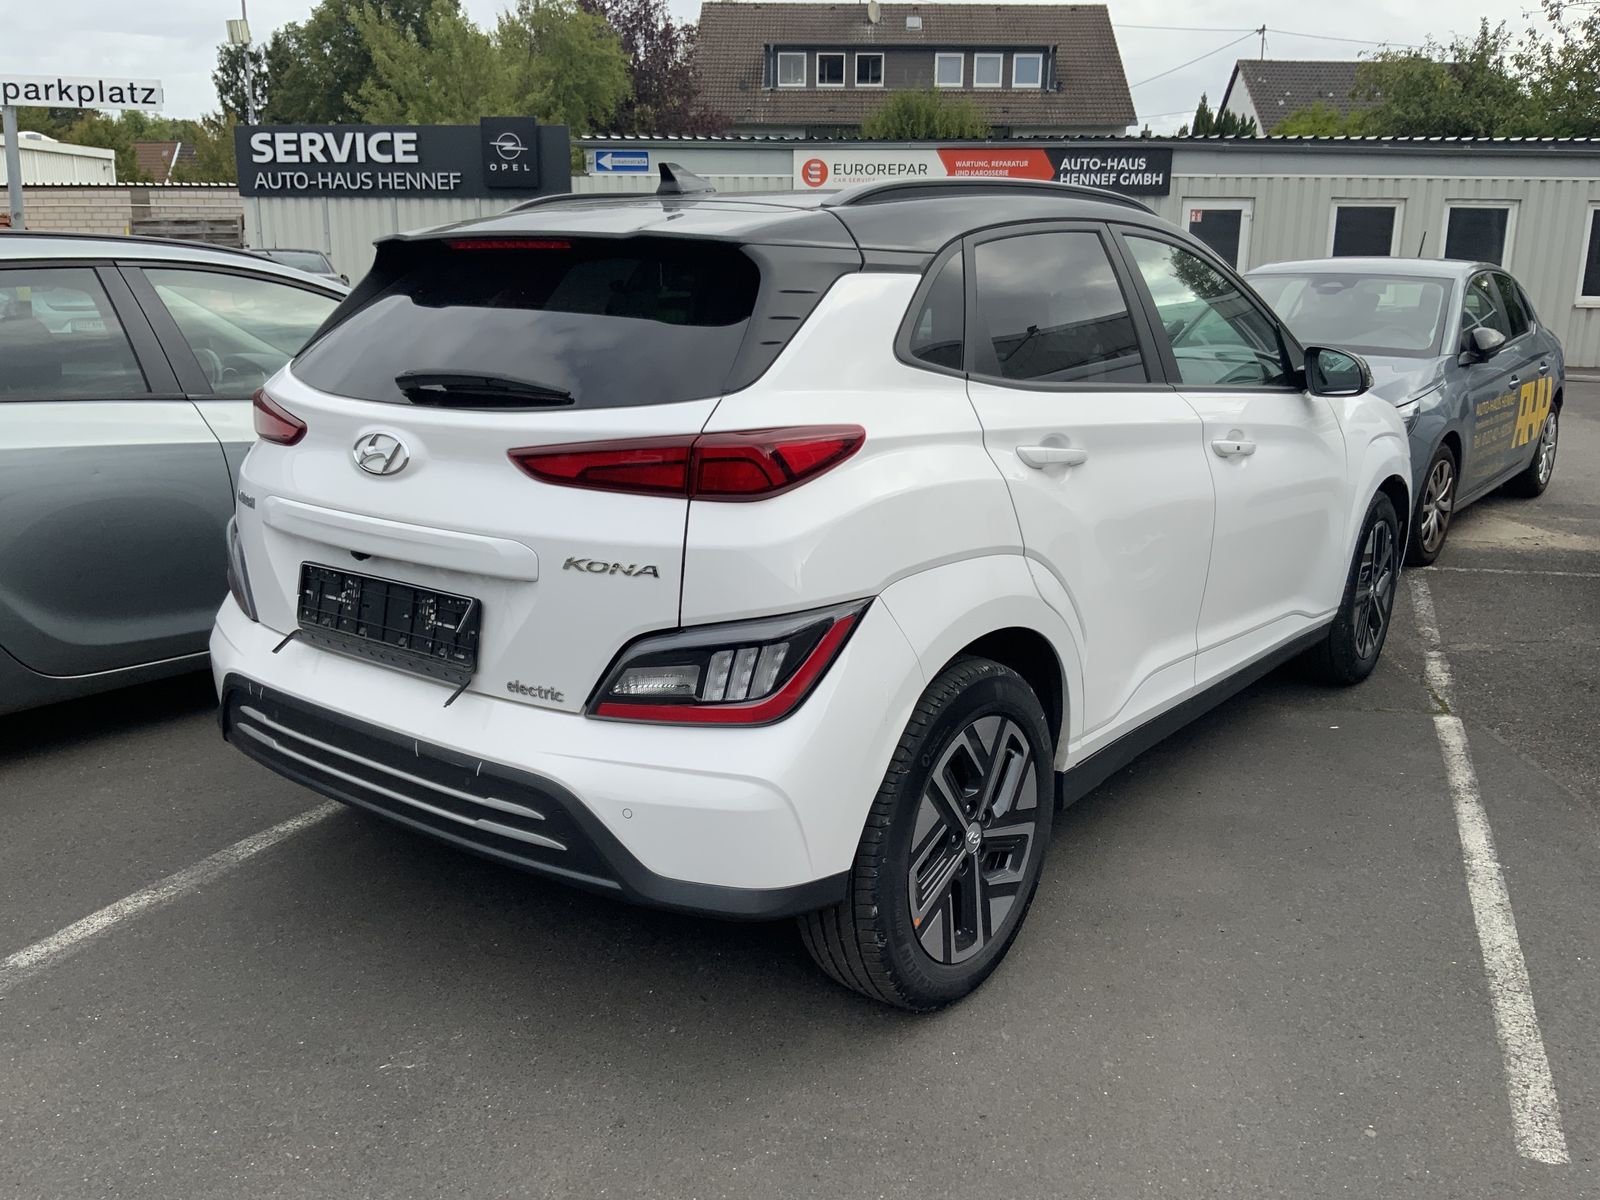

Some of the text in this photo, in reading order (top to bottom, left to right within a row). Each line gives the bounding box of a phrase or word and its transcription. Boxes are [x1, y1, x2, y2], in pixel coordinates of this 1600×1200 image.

[3, 78, 157, 108] parkplatz
[250, 132, 419, 163] SERVICE
[833, 163, 928, 176] EUROREPAR
[955, 161, 990, 169] WARTUNG,
[1060, 157, 1147, 171] AUTO-HAUS
[254, 172, 462, 191] AUTO-HAUS HENNEF
[1060, 173, 1163, 186] HENNEF GMBH
[562, 557, 660, 578] KONA
[506, 680, 565, 702] electric
